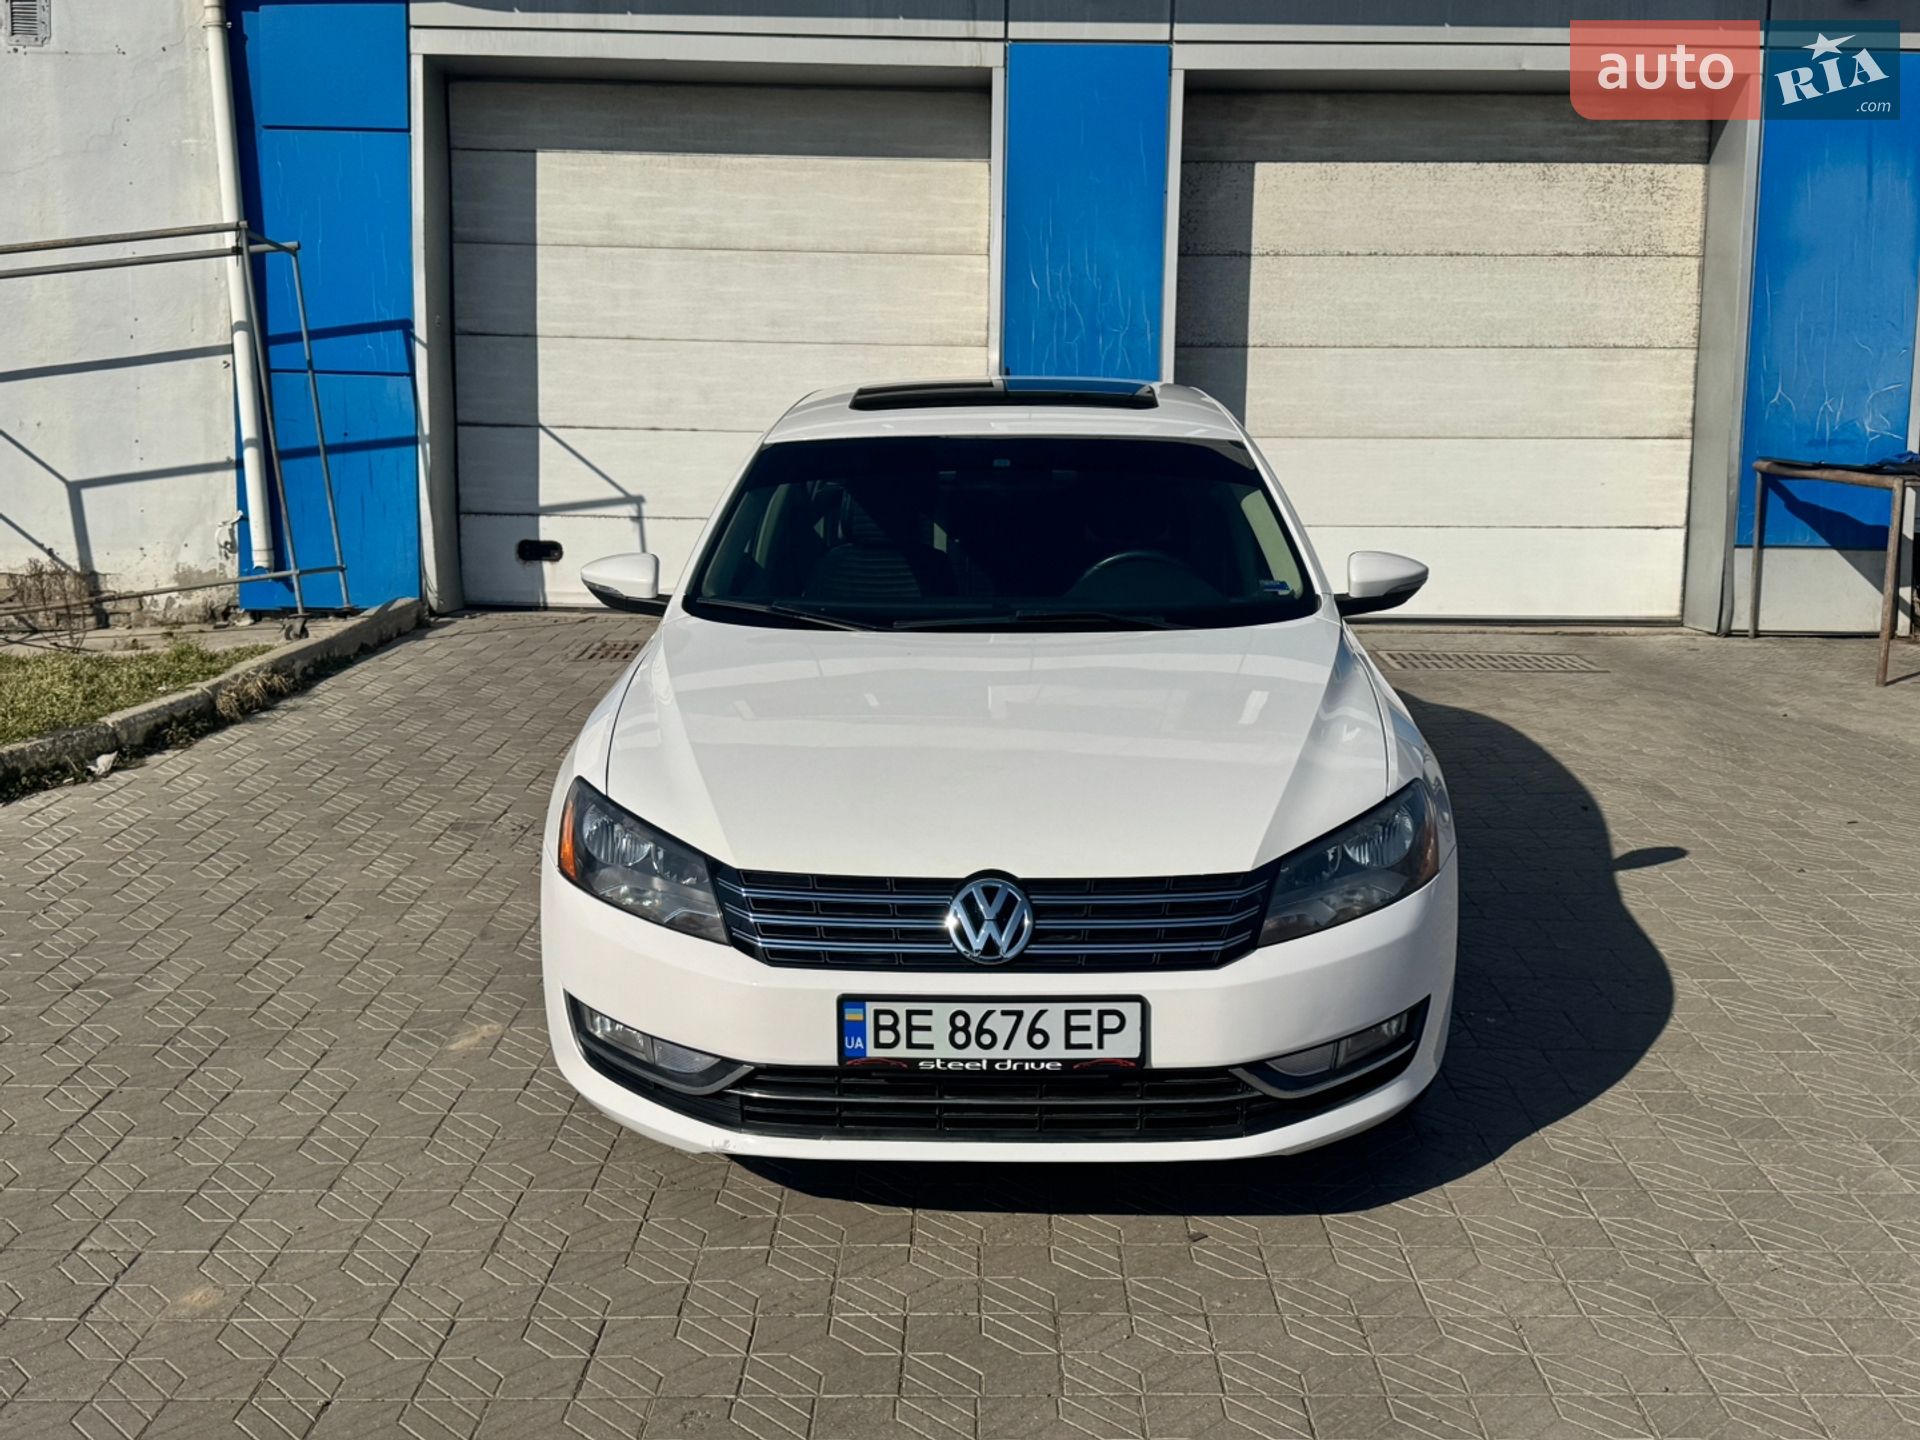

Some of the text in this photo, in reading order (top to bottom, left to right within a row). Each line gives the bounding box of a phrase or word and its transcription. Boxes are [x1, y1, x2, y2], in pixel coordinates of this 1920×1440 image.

[873, 1009, 1127, 1051] BE 8676 EP
[844, 1036, 864, 1049] UA
[918, 1058, 1063, 1071] steel drive
